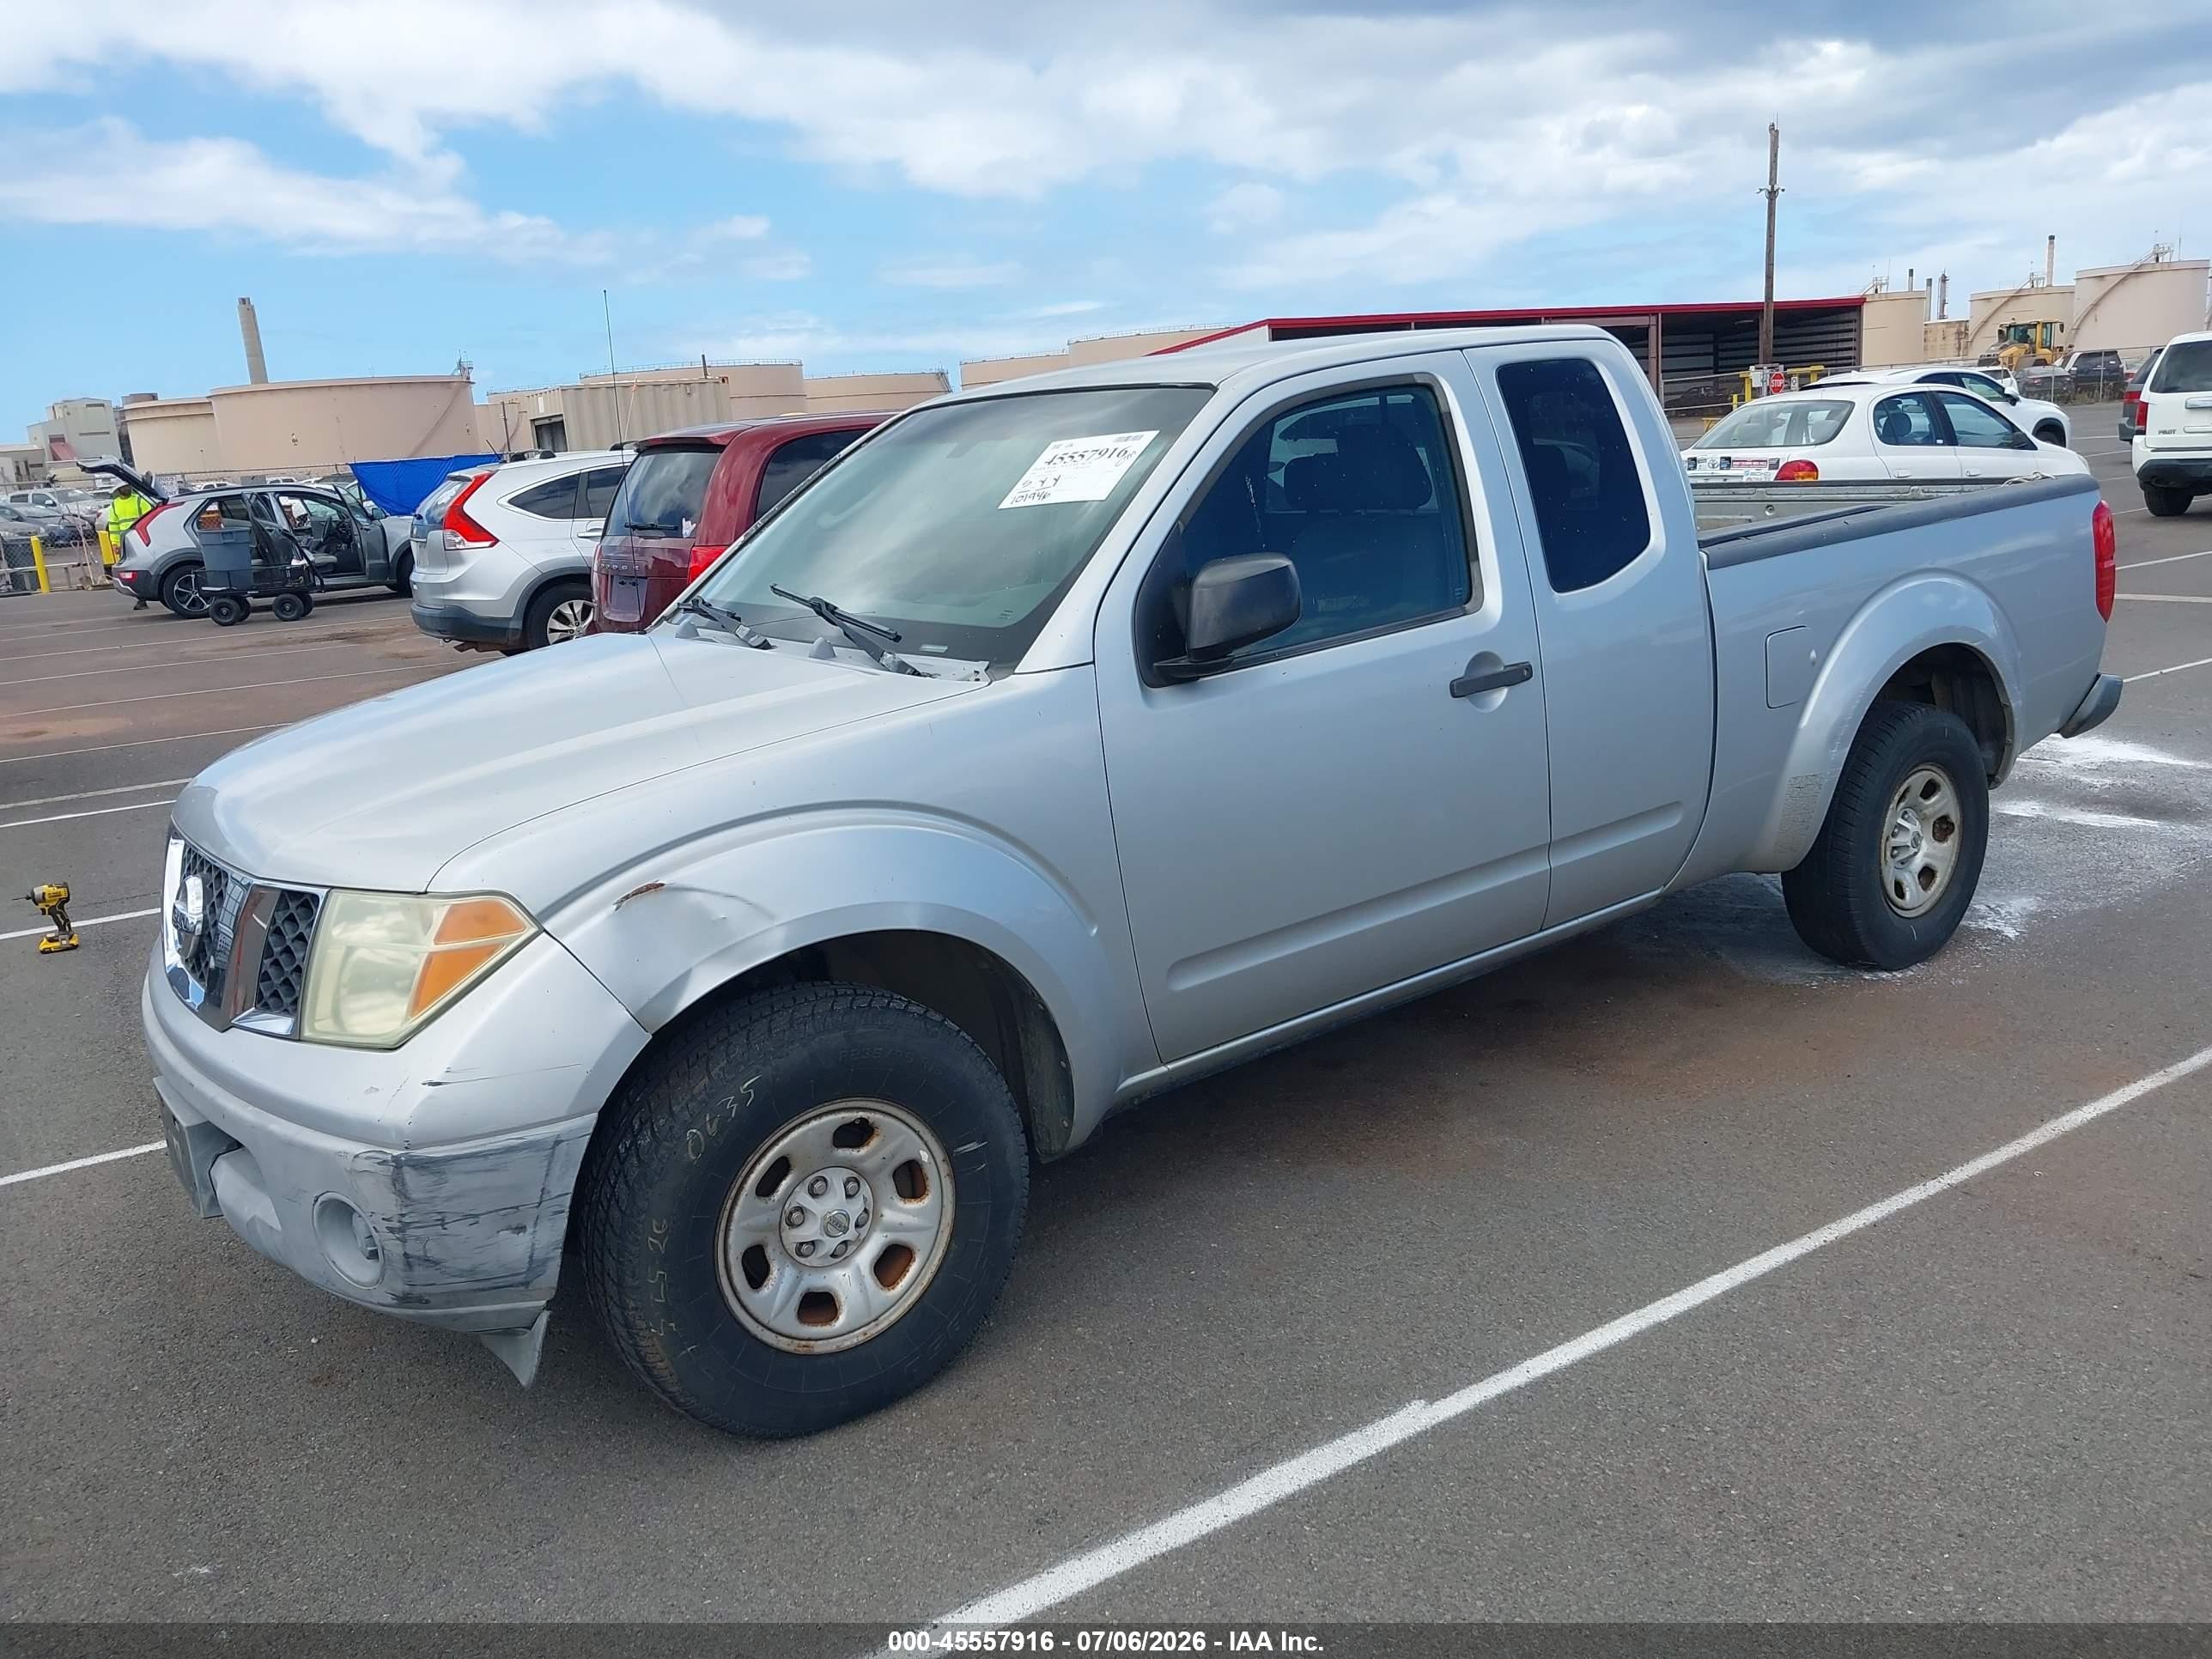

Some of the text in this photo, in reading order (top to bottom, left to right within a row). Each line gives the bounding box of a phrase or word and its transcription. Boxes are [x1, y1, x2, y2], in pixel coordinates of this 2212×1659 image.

[1771, 379, 1784, 388] STOP
[1044, 446, 1133, 465] 45557916
[599, 562, 640, 571] DODGE
